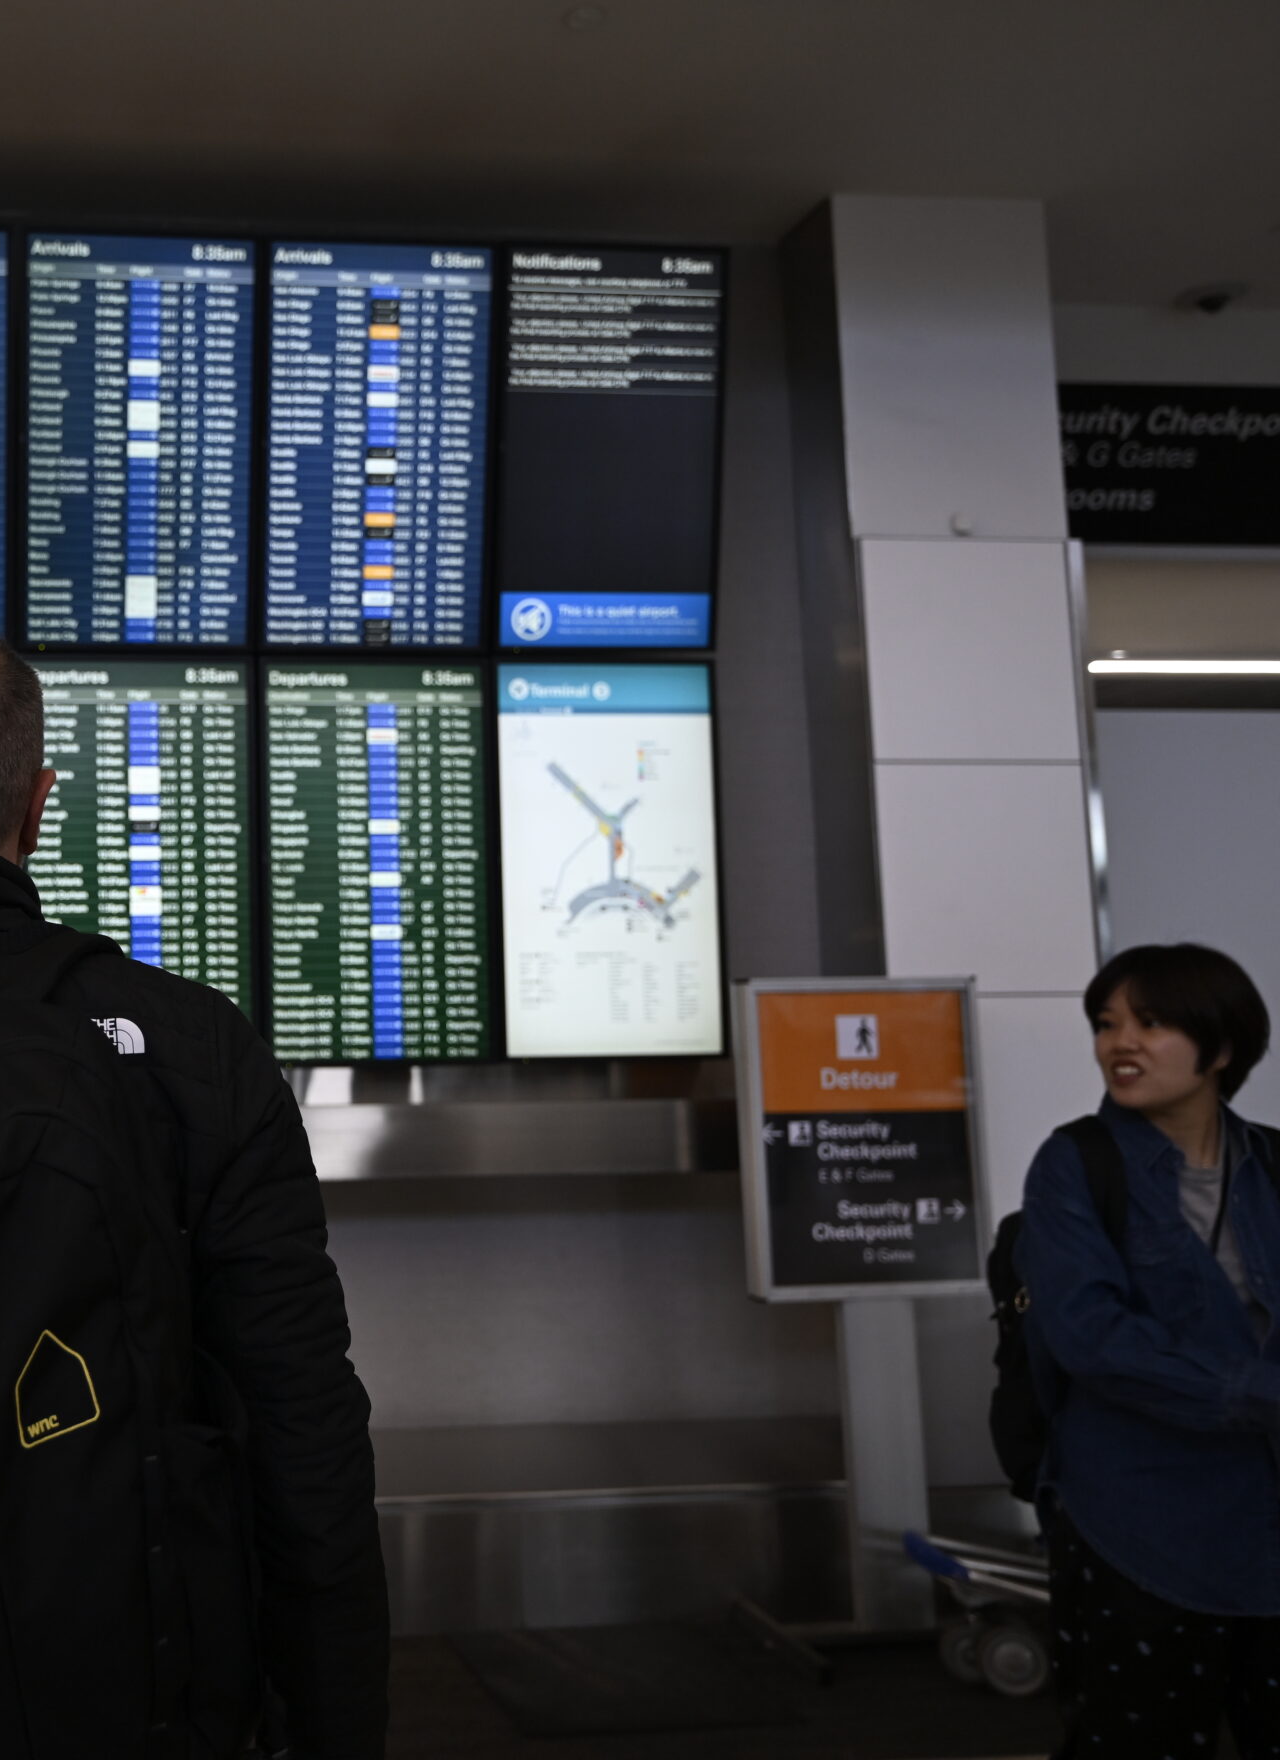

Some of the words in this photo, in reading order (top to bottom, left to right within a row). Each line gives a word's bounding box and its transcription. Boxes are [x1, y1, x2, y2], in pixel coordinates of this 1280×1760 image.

[31, 240, 90, 257] Arrivals
[275, 248, 332, 266] Arrivals
[512, 253, 602, 271] Notifications
[1061, 403, 1139, 439] urity
[1146, 404, 1280, 442] Checkpo
[1068, 488, 1157, 511] ooms
[36, 669, 109, 685] epartures
[269, 670, 348, 688] Departures
[531, 683, 589, 698] Terminal
[820, 1068, 898, 1090] Detour
[816, 1120, 890, 1141] Security
[817, 1142, 917, 1162] Checkpoint
[837, 1201, 911, 1221] Security
[812, 1223, 913, 1242] Checkpoint
[27, 1414, 60, 1439] wnc
